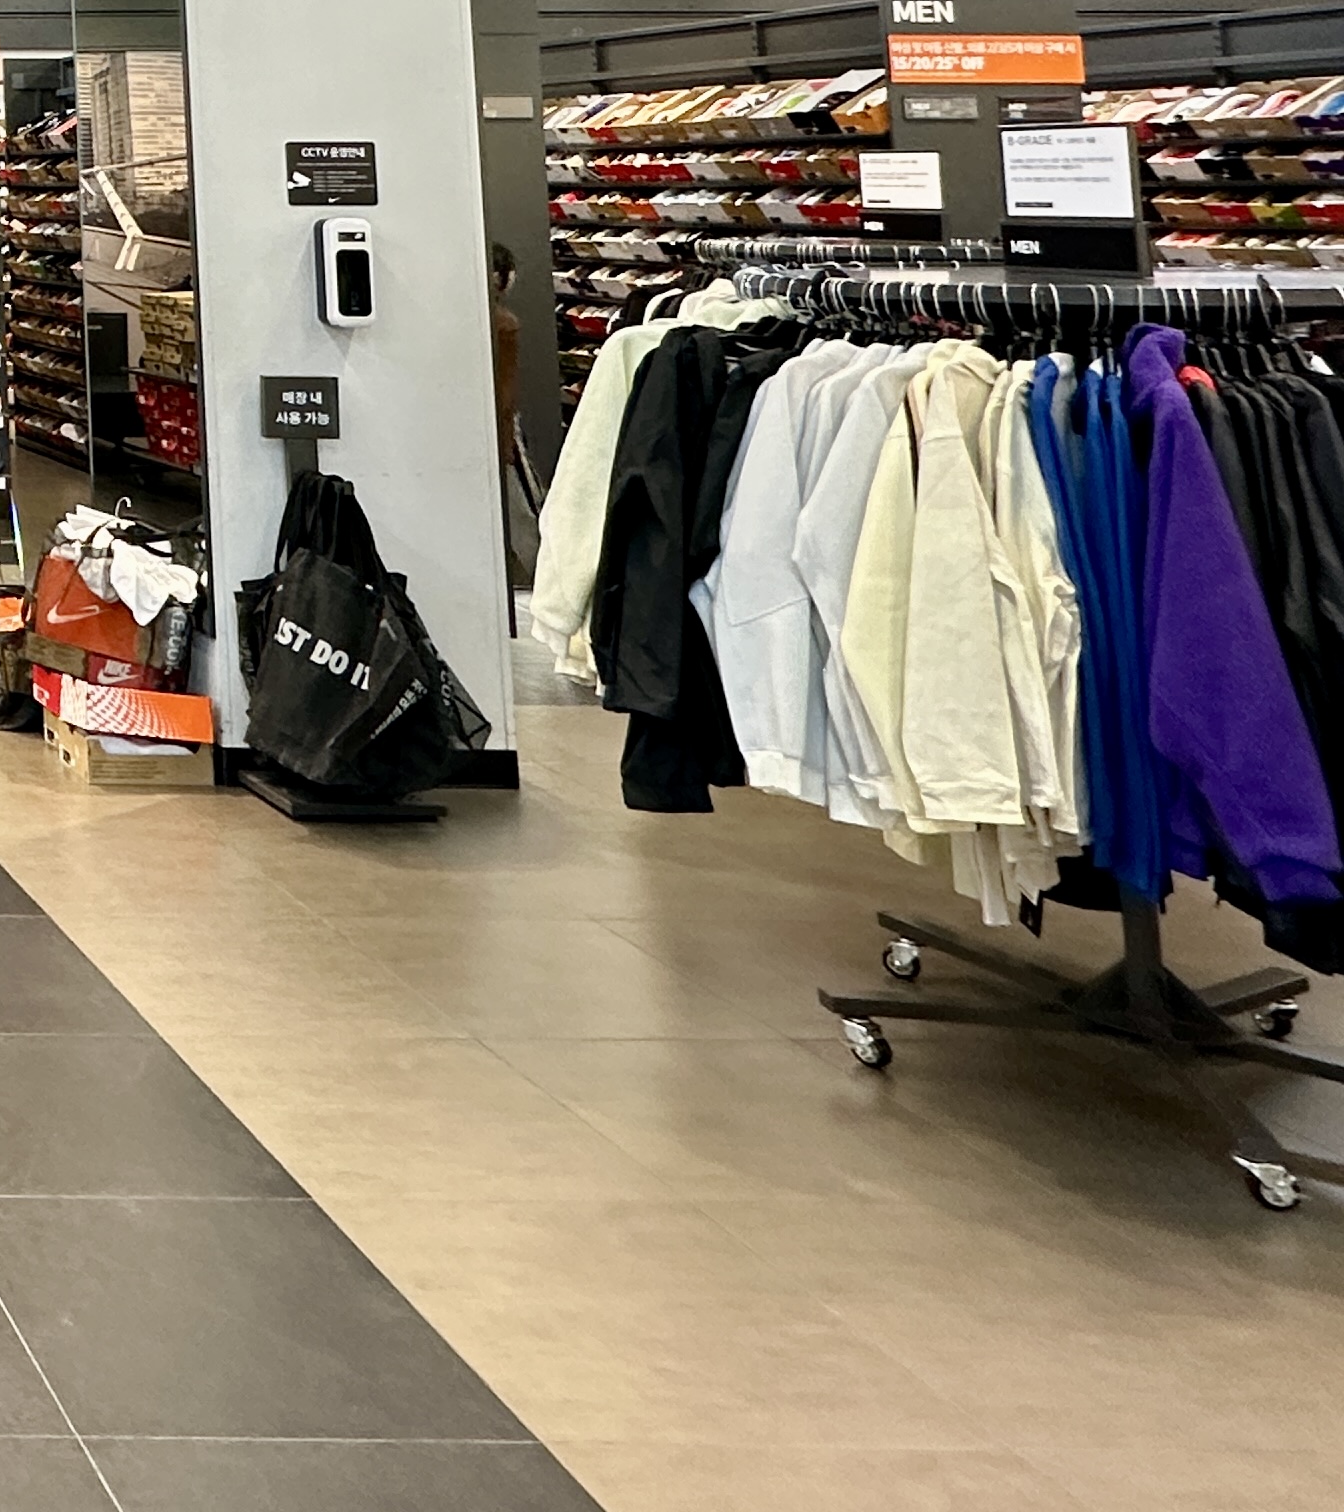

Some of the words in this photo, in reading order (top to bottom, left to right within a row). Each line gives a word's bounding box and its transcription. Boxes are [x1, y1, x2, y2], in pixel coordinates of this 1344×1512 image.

[892, 0, 955, 24] MEN
[960, 56, 984, 70] OFF
[300, 147, 328, 158] CCTV
[1010, 240, 1041, 255] MEN
[281, 391, 307, 405] 매장
[309, 391, 323, 405] 내
[275, 411, 302, 425] 사용
[303, 411, 330, 426] 가능
[274, 617, 312, 653] ST
[309, 639, 350, 676] DO
